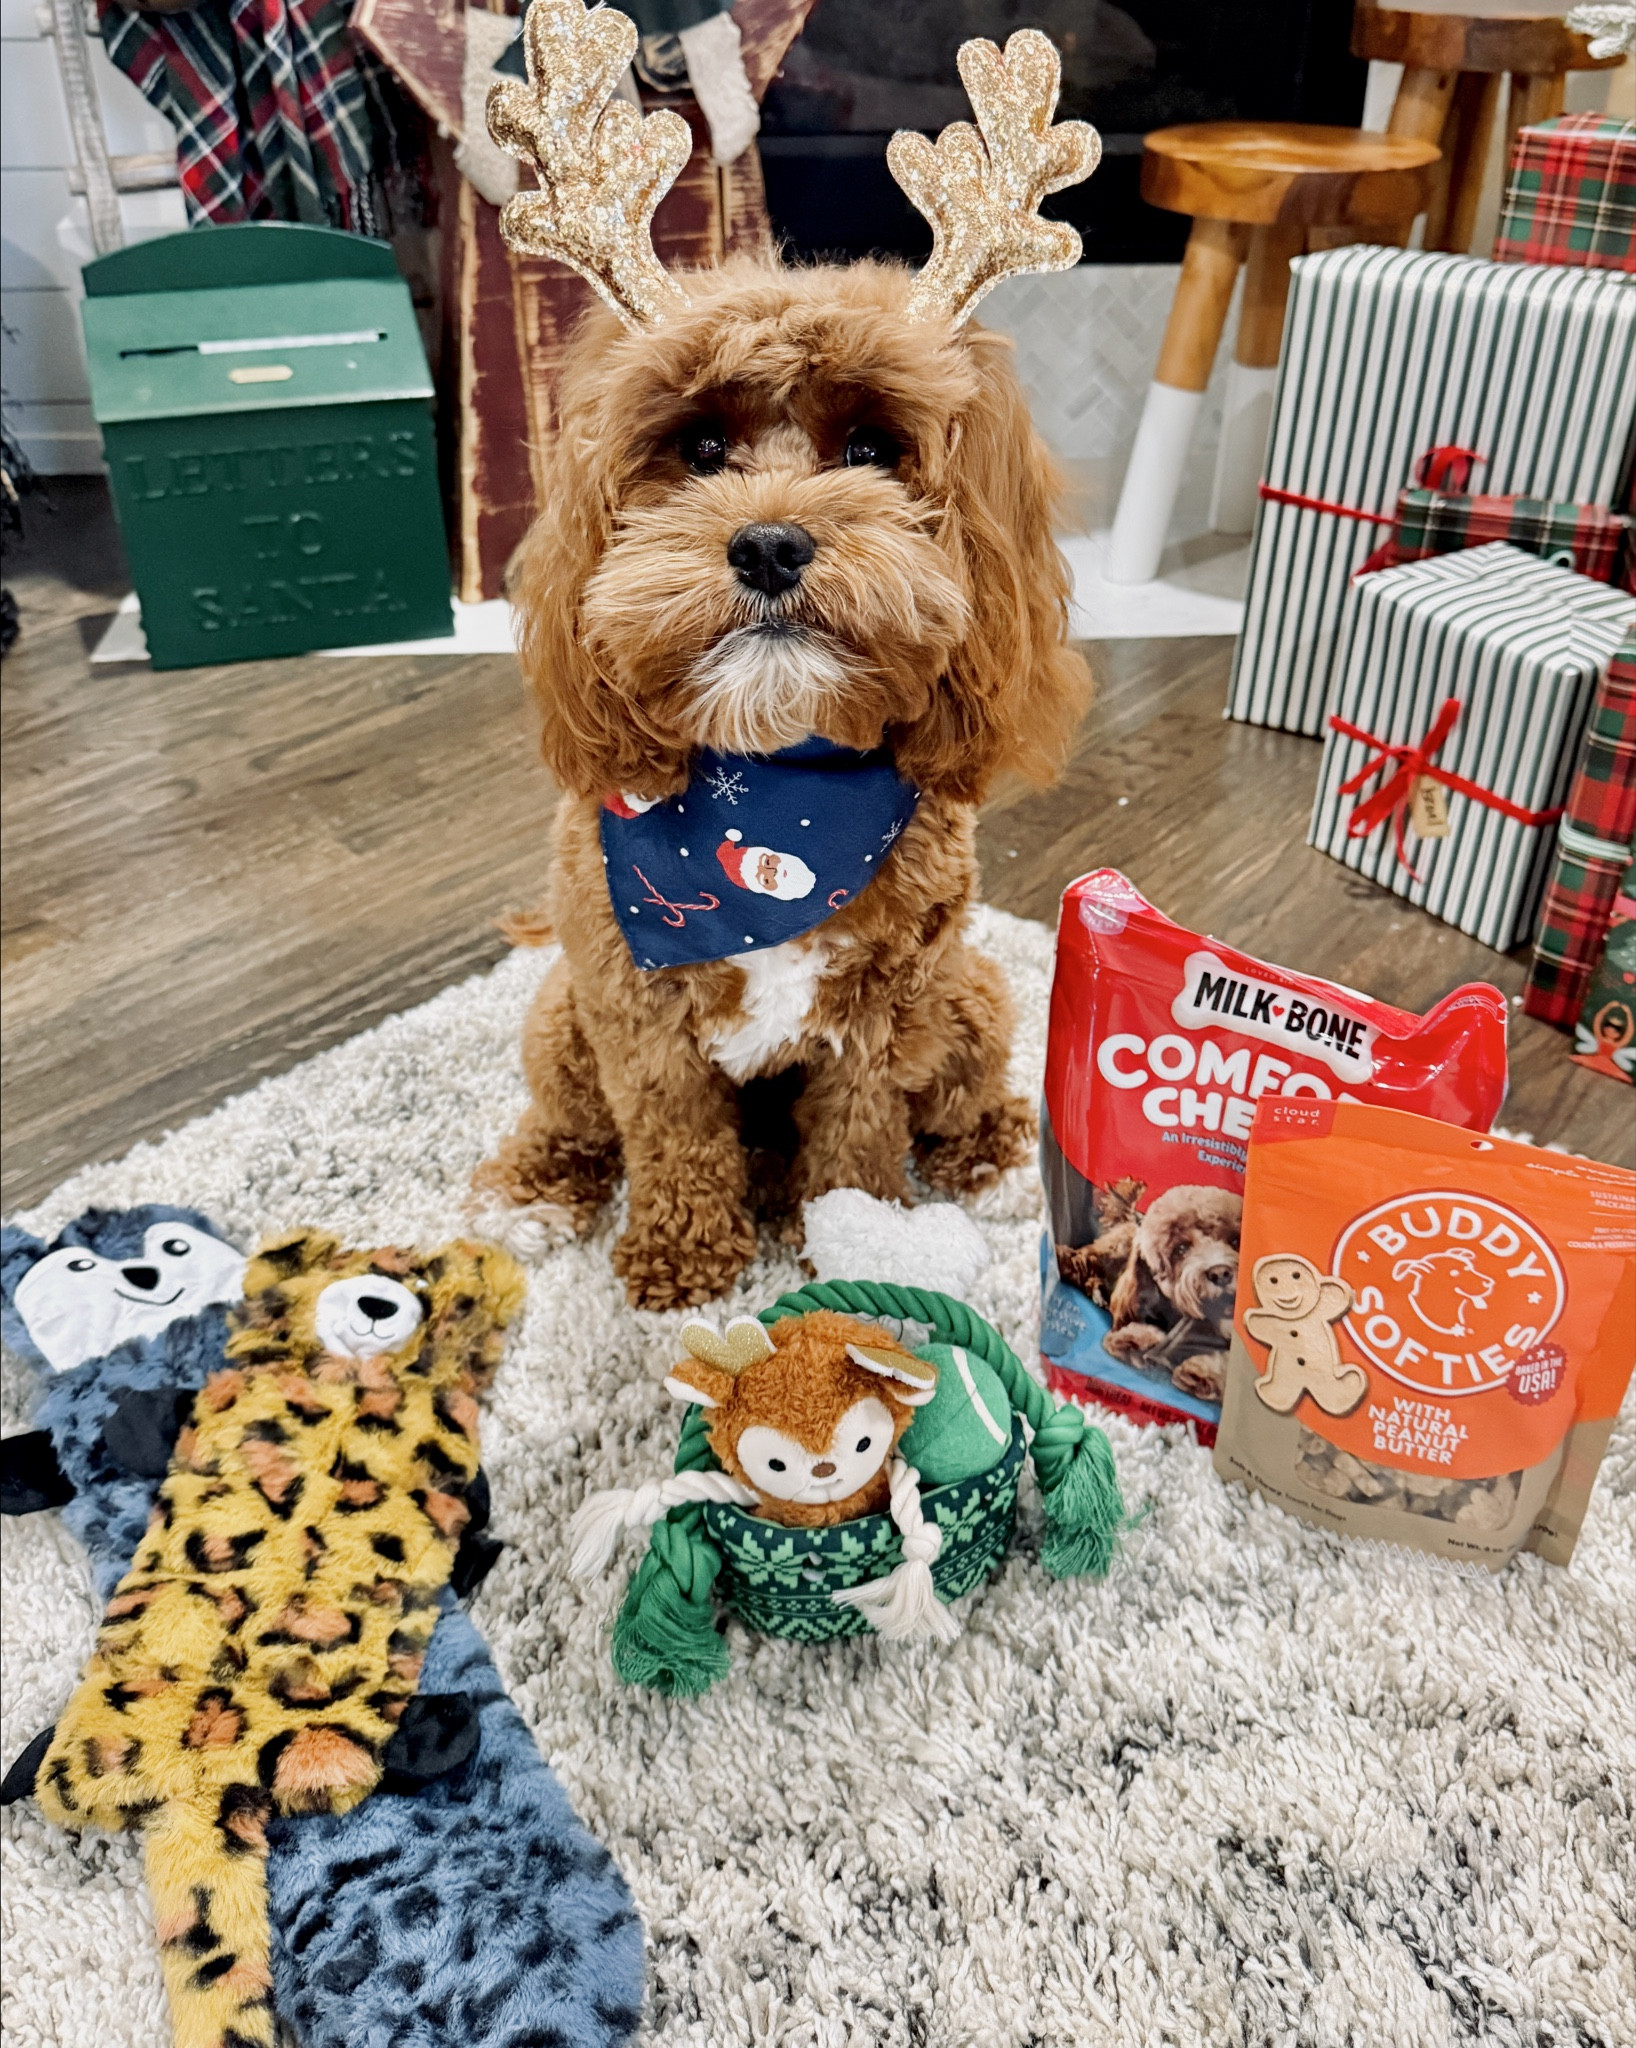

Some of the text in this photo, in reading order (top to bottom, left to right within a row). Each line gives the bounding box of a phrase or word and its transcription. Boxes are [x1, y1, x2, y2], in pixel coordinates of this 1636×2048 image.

[125, 431, 418, 499] LETTERS
[242, 511, 323, 559] TO
[193, 569, 408, 632] SANTA
[1097, 1033, 1363, 1104] COMFO
[1274, 1106, 1320, 1118] cloud
[1162, 1131, 1179, 1143] An
[1367, 1206, 1546, 1278] BUDDY
[1352, 1286, 1537, 1385] SOFTIES
[1515, 1356, 1563, 1376] BAKED IN THE
[1518, 1368, 1556, 1394] USA!
[1368, 1404, 1469, 1440] NATURAL
[1393, 1396, 1451, 1423] WITH
[1373, 1420, 1461, 1452] PEANUT
[1373, 1435, 1453, 1466] BUTTER
[1448, 1538, 1464, 1546] Net
